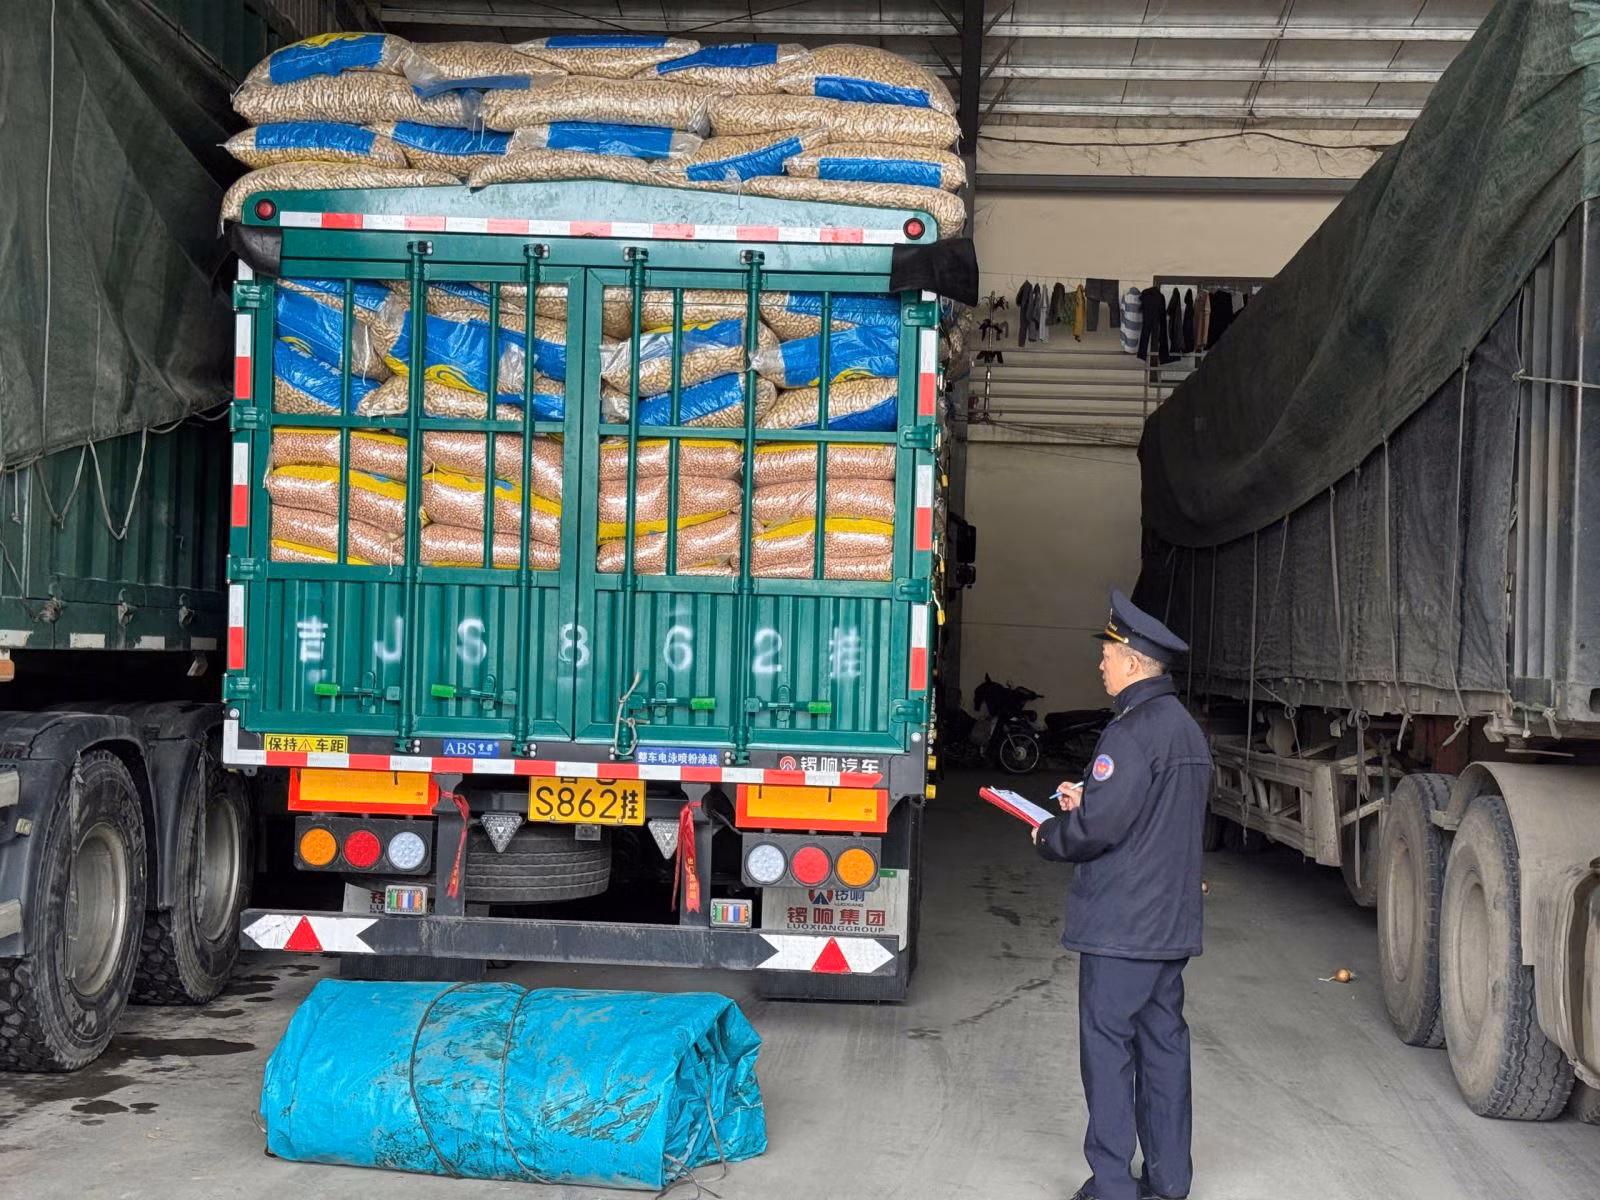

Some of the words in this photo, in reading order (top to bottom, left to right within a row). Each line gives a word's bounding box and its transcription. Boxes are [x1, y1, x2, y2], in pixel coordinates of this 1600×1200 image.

[268, 737, 297, 752] 保持
[315, 738, 345, 753] 车距
[444, 742, 476, 755] ABS
[637, 752, 718, 765] 整车电泳喷粉涂装
[535, 786, 639, 819] S862挂
[787, 923, 885, 933] LUOXIANGGROUP
